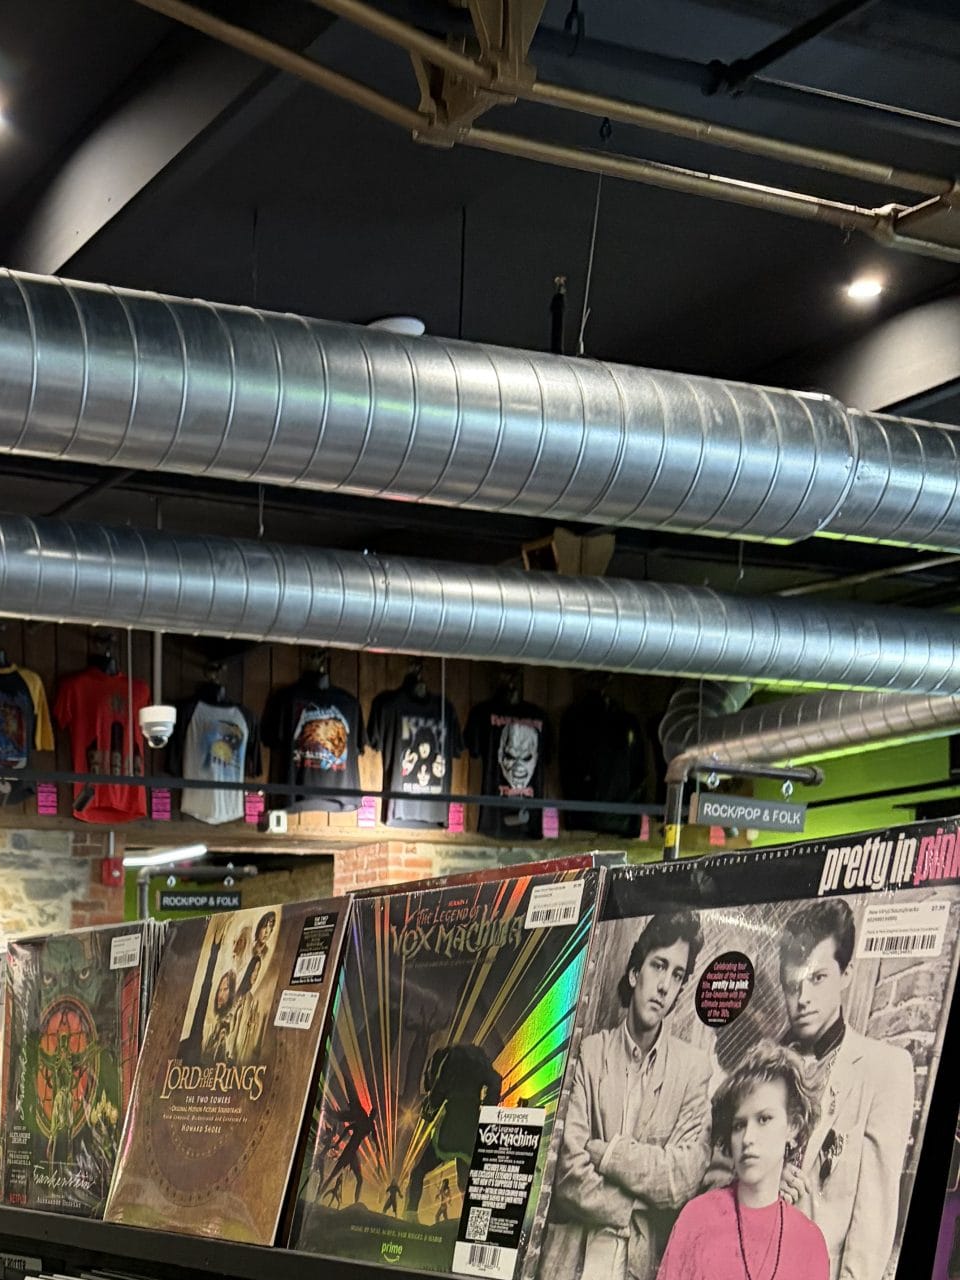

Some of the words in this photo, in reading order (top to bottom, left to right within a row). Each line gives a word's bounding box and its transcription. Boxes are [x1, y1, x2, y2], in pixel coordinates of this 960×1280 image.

[703, 803, 761, 820] ROCK/POP
[762, 809, 770, 822] &
[772, 811, 801, 825] FOLK
[704, 854, 747, 868] PICTURE
[755, 844, 827, 862] SOUNDTRACK
[818, 836, 894, 896] pretty
[889, 832, 918, 884] in
[162, 896, 207, 906] ROCK/POP
[208, 897, 215, 906] &
[217, 897, 239, 906] FOLK
[433, 904, 469, 923] LEGEND
[390, 922, 434, 960] VOX
[711, 981, 729, 991] pretty
[734, 980, 749, 991] pink
[160, 1059, 201, 1099] LORD
[203, 1067, 214, 1077] OF
[210, 1062, 267, 1101] RINGS
[200, 1078, 213, 1088] THE
[185, 1095, 195, 1103] THE
[196, 1096, 208, 1104] TWO
[210, 1096, 231, 1104] TOWERS
[181, 1124, 203, 1133] HOWARD
[204, 1125, 222, 1134] SHORE
[479, 1125, 500, 1145] VOX
[381, 1241, 403, 1254] prime
